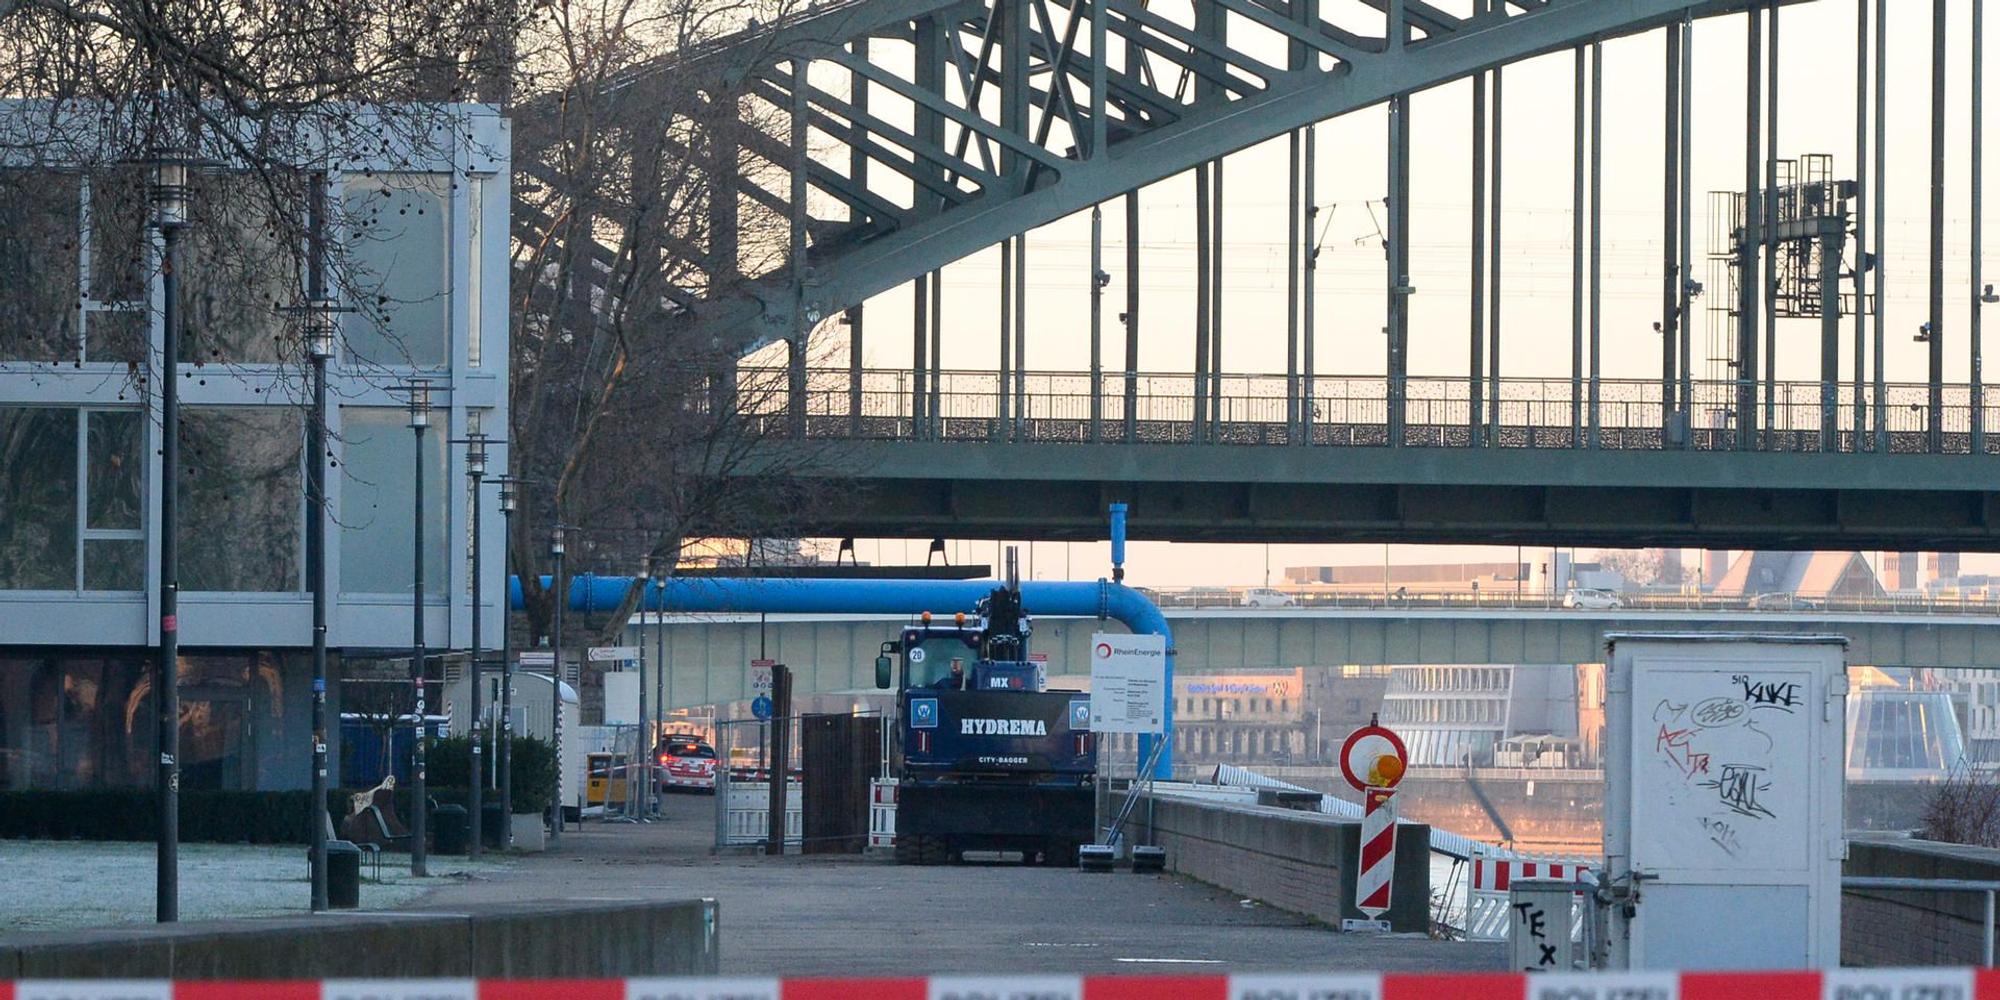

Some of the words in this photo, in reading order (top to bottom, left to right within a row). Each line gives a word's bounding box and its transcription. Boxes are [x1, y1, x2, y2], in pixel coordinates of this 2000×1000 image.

[912, 650, 922, 660] 20
[1113, 648, 1161, 657] RheinEnergie
[961, 718, 1047, 736] HYDREMA
